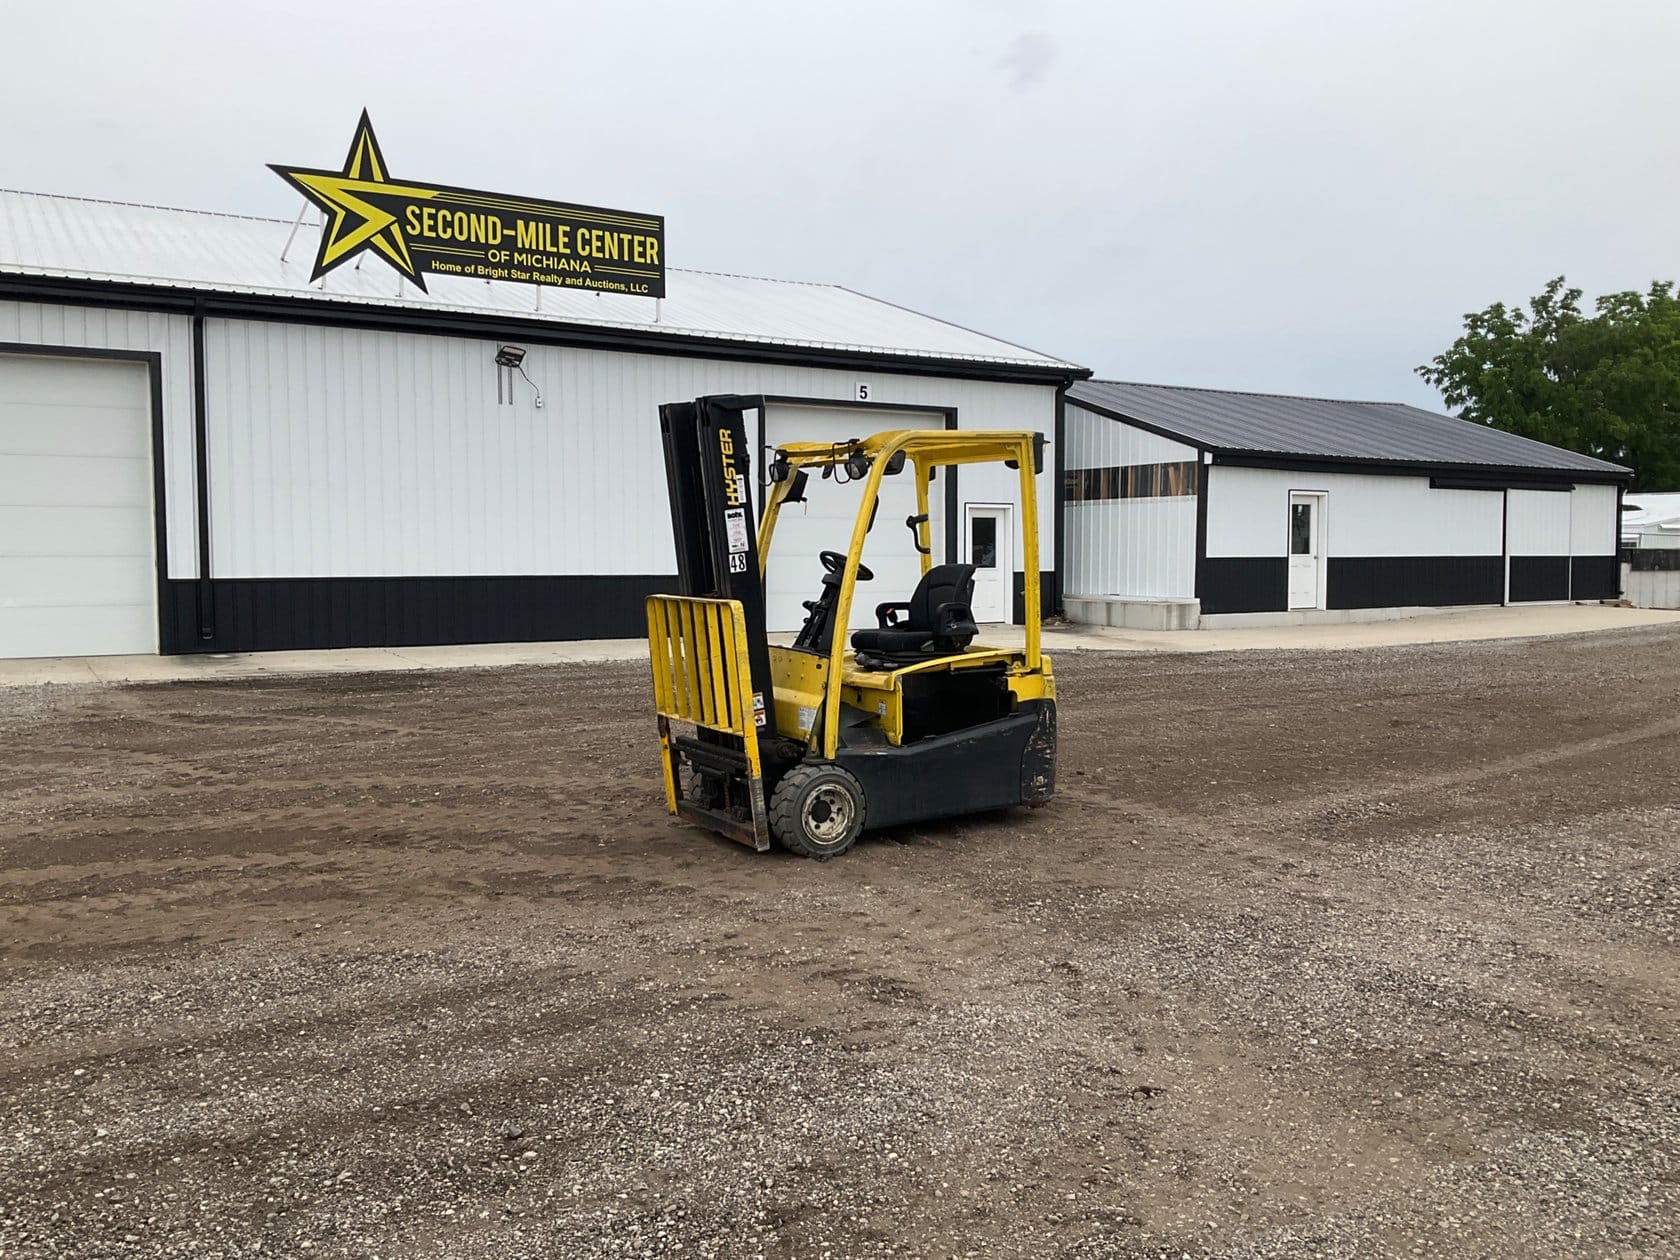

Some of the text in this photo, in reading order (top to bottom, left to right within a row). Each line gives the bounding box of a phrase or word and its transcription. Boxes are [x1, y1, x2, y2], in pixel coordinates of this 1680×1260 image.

[405, 205, 659, 265] SECOND-MILE CENTER
[488, 249, 592, 274] OF MICHIANA
[431, 260, 649, 293] Home of Bright Star Realty and Auctions, LLC
[859, 385, 868, 400] 5
[719, 428, 740, 506] HYSTER
[730, 555, 746, 572] 48
